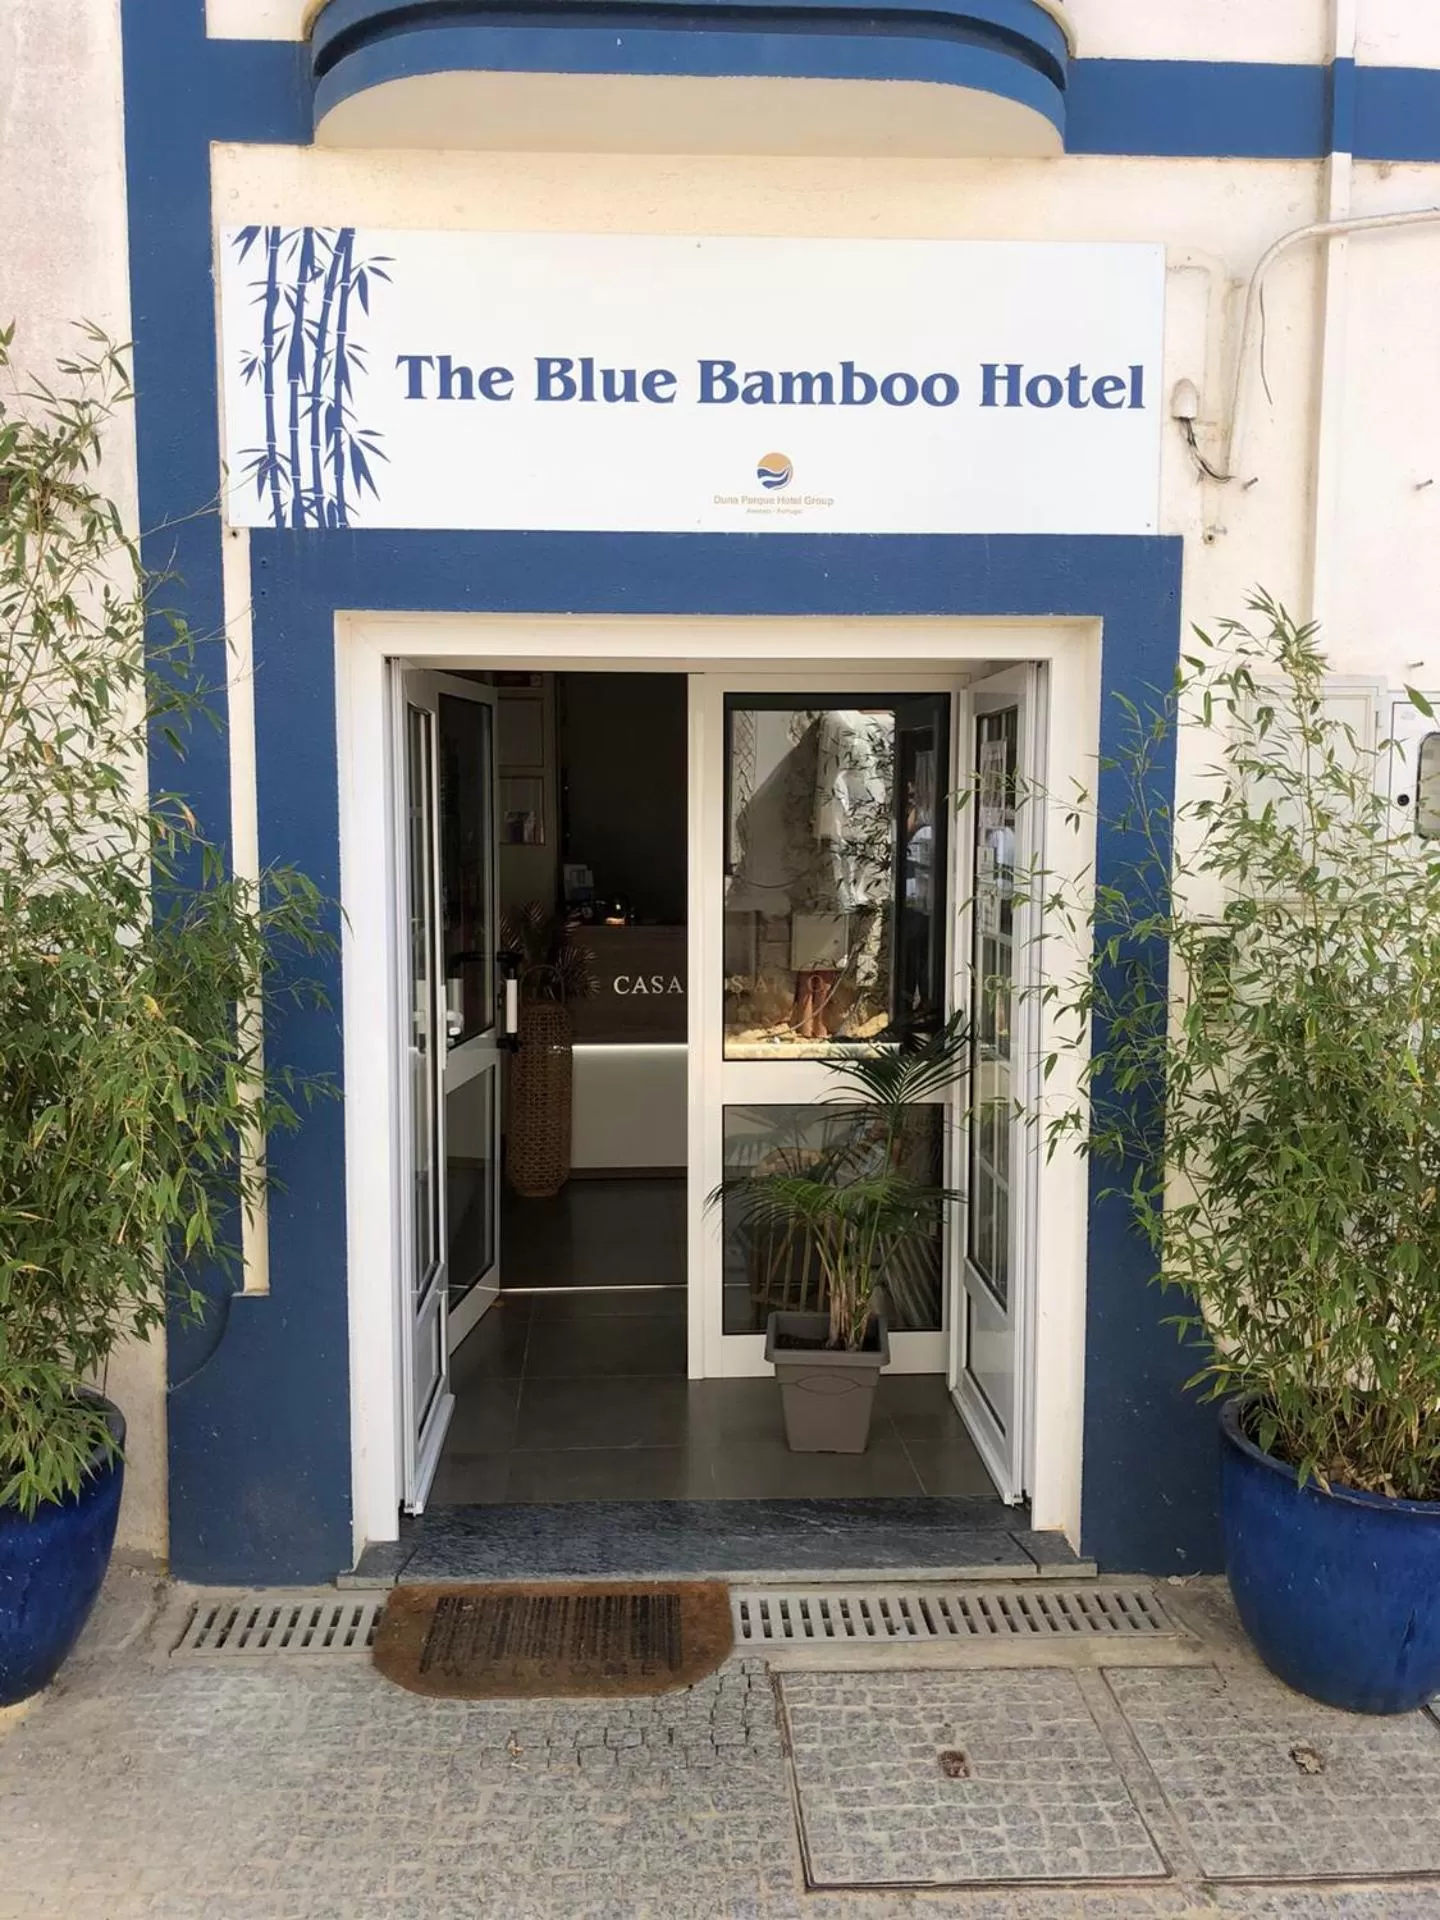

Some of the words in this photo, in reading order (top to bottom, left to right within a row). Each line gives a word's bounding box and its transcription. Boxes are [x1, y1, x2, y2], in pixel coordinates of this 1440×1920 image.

[395, 354, 514, 402] The
[534, 357, 678, 404] Blue
[697, 359, 960, 407] Bamboo
[979, 363, 1146, 410] Hotel
[713, 494, 739, 505] Duna
[777, 494, 802, 506] Hotel
[804, 496, 834, 508] Group
[613, 975, 685, 995] CASA
